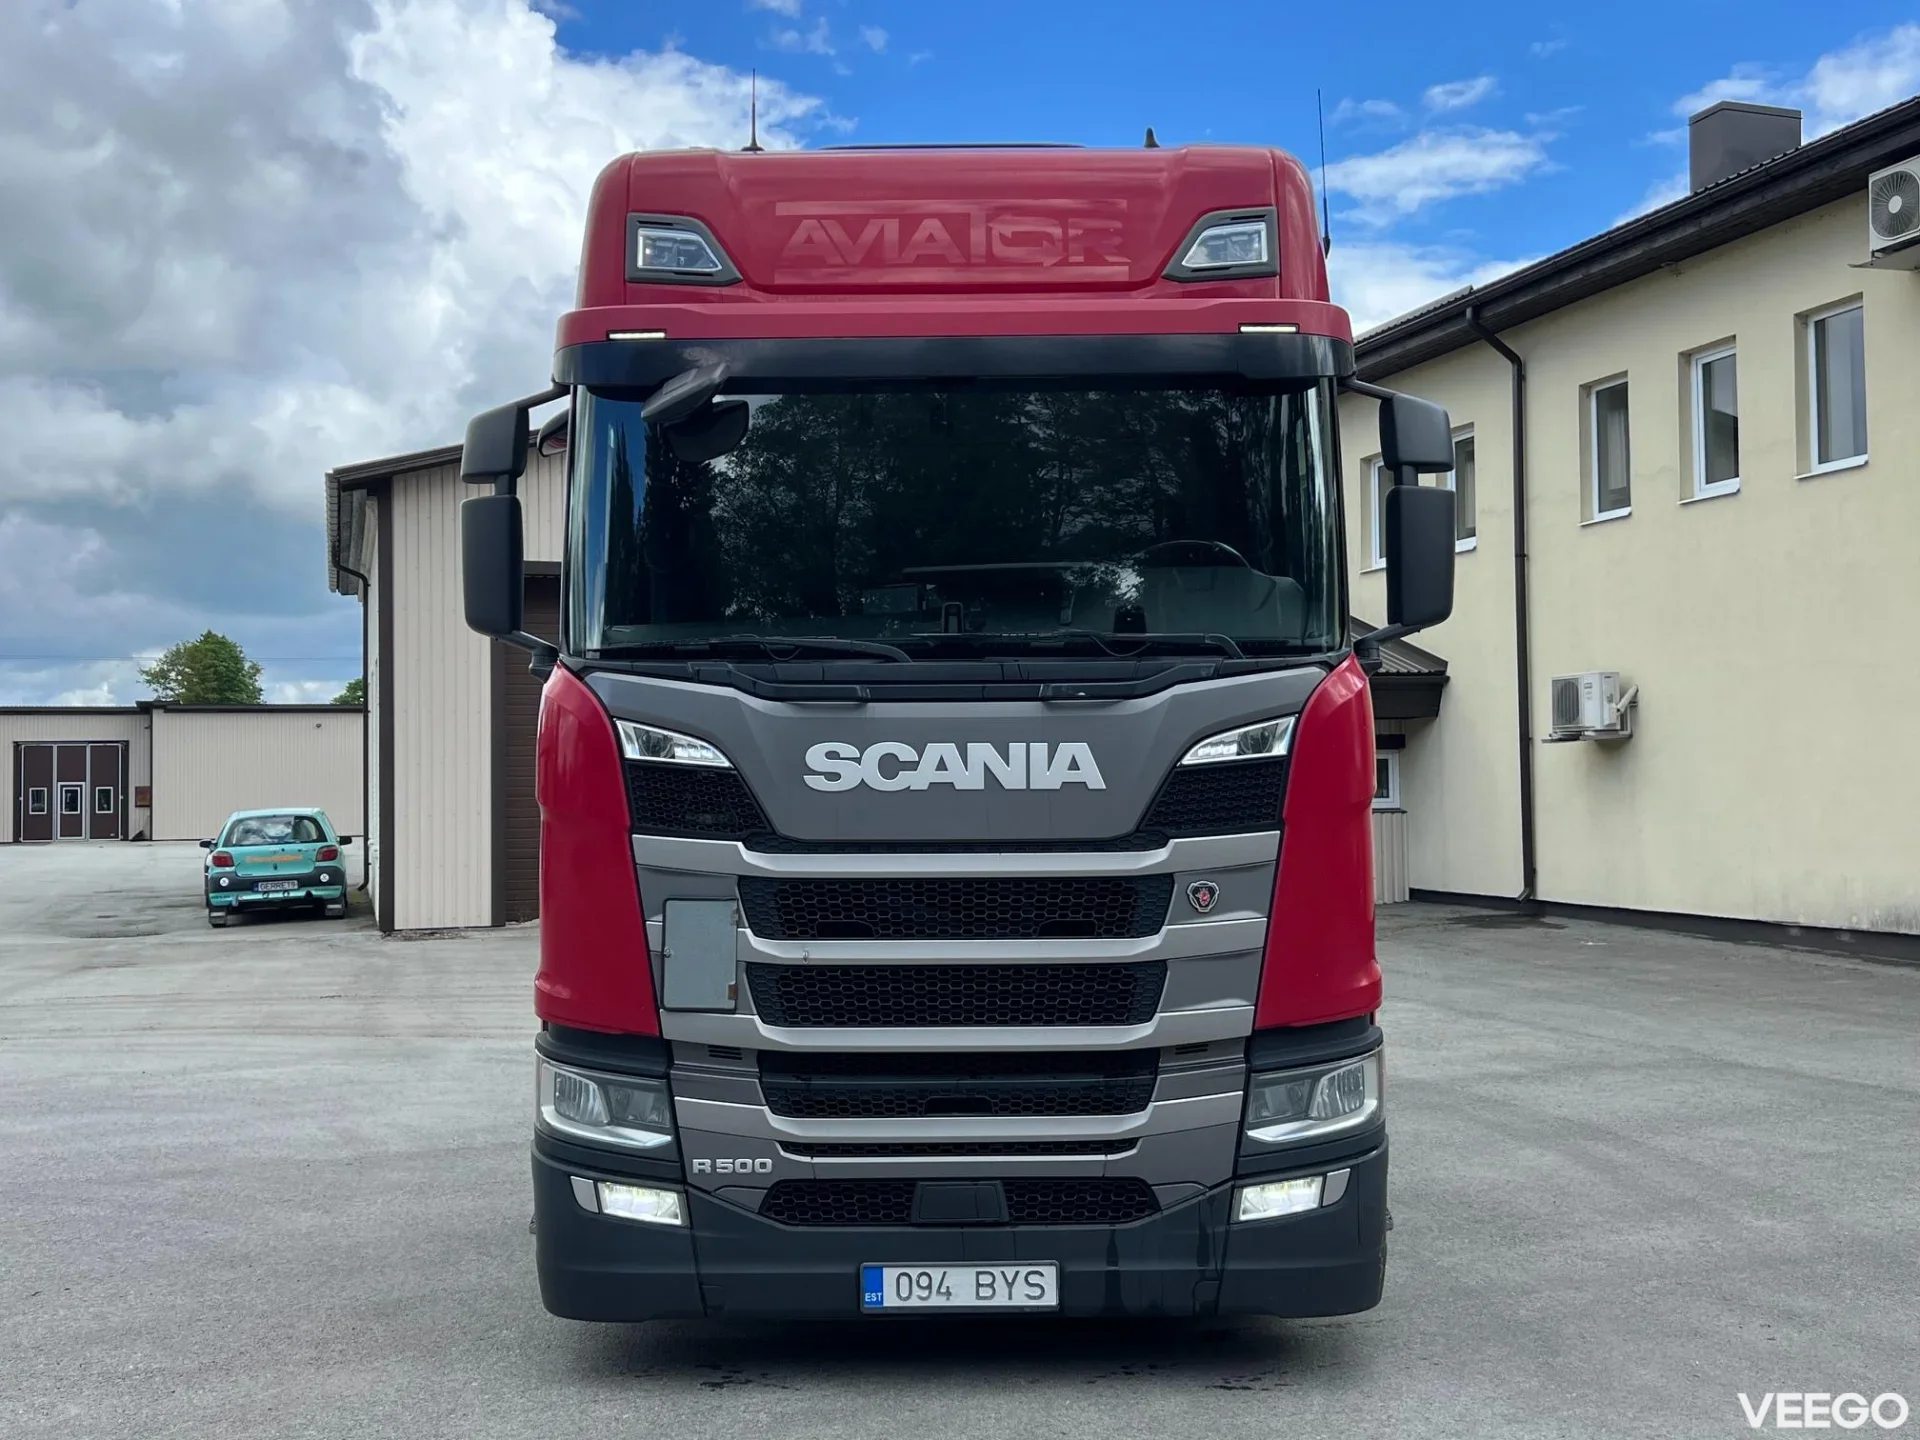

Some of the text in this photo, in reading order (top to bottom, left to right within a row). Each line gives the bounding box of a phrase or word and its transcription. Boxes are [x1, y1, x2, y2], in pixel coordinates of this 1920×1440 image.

[780, 207, 1132, 268] AVIATOR
[802, 741, 1107, 792] SCANIA
[864, 1292, 882, 1302] EST
[895, 1269, 1046, 1302] 094 BYS
